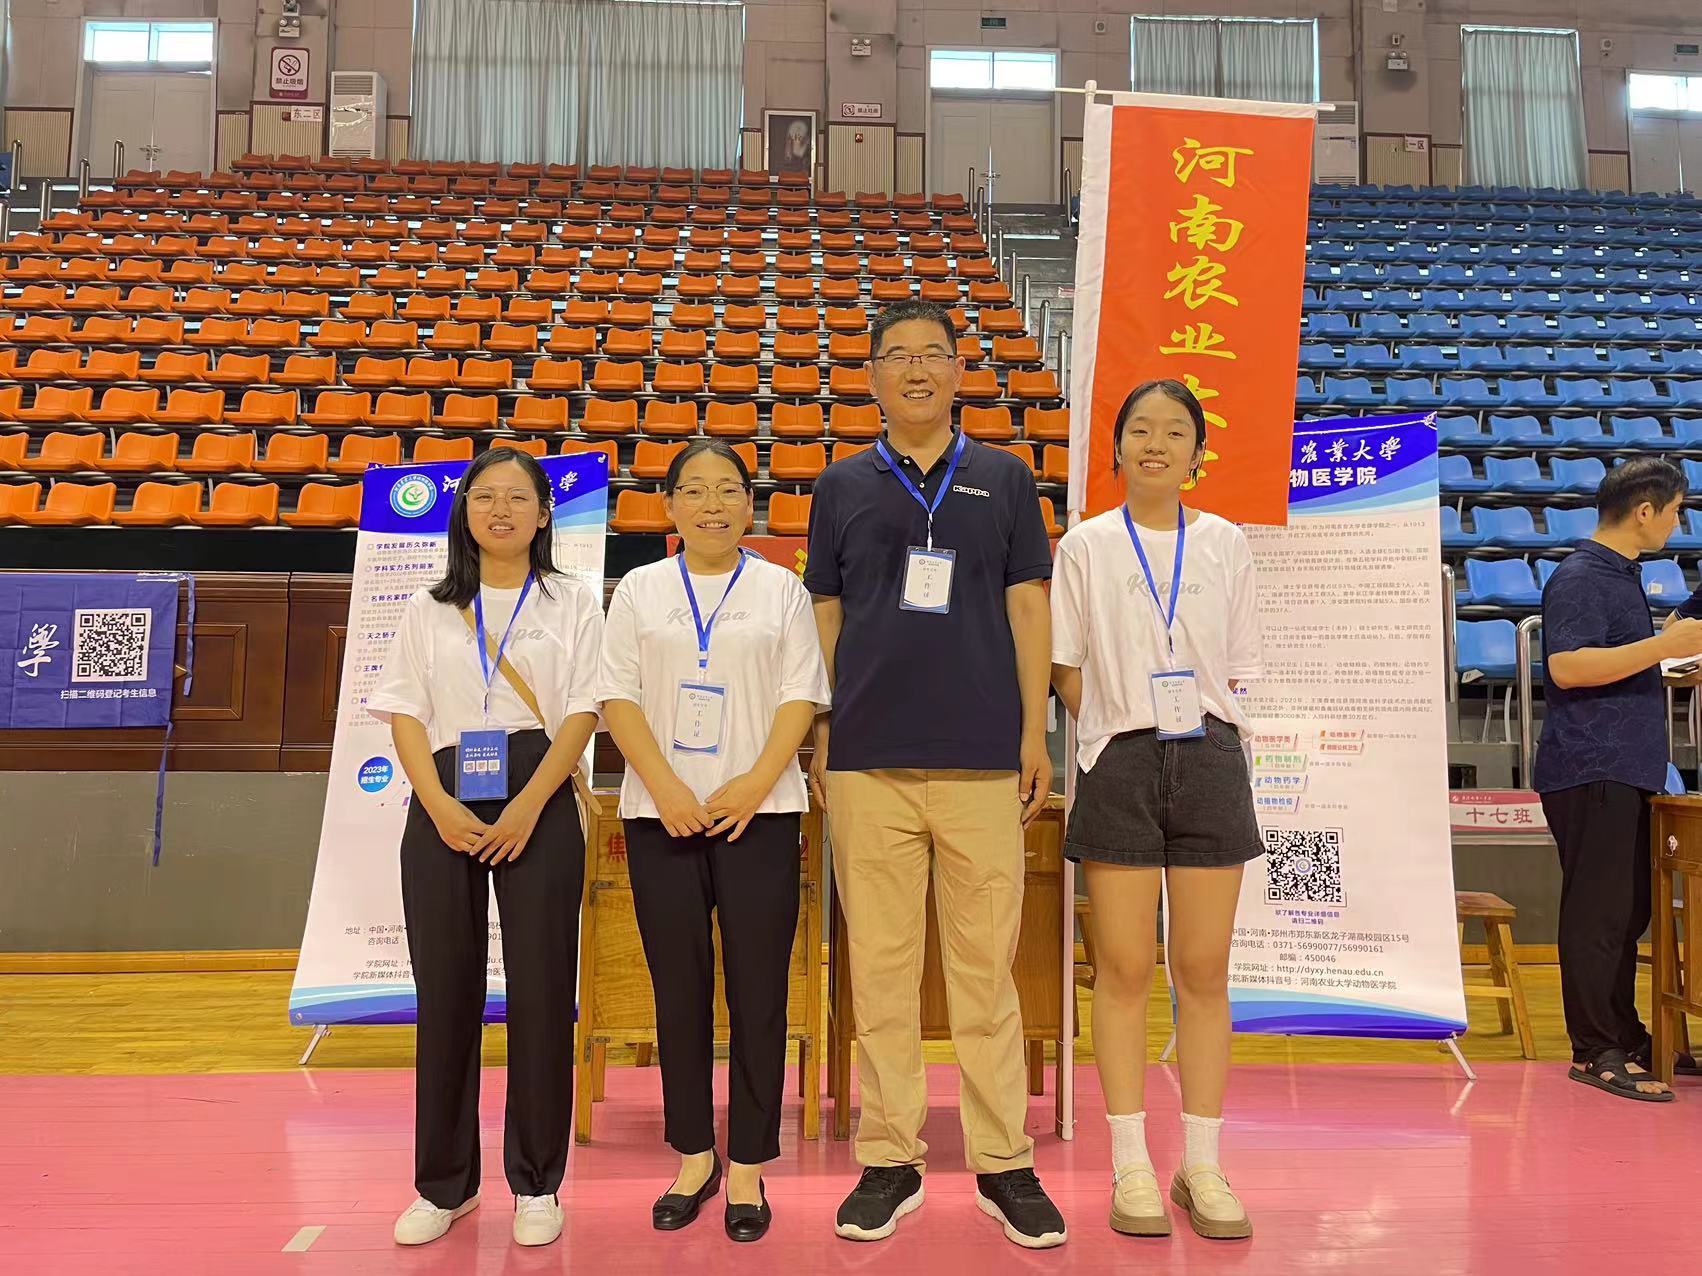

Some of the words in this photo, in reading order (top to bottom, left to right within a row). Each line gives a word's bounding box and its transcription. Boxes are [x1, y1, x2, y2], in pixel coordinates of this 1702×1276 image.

[293, 108, 321, 119] 东二区
[1289, 466, 1378, 487] 物医学院
[60, 688, 158, 700] 扫描二维码登记考生信息
[1465, 807, 1533, 824] 十七班
